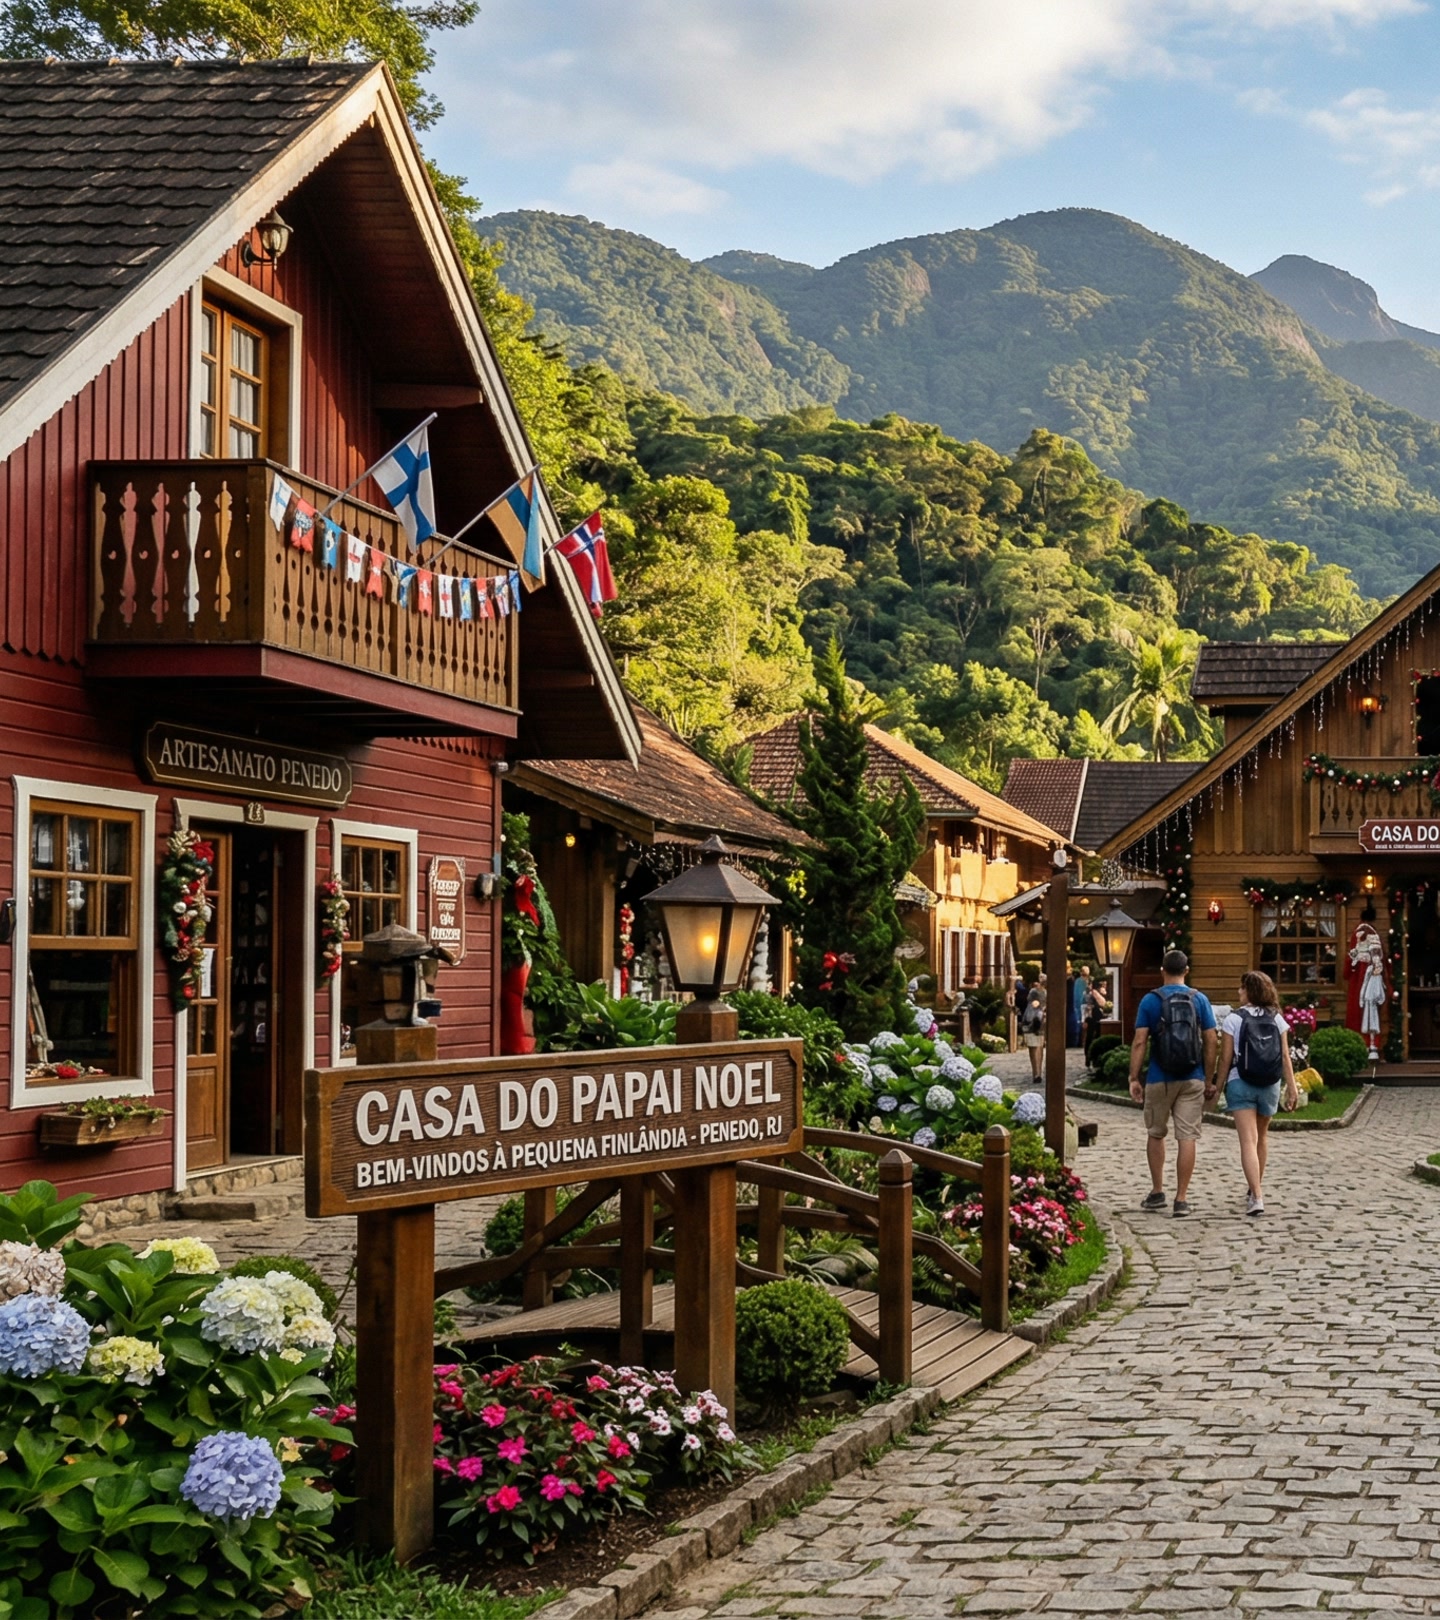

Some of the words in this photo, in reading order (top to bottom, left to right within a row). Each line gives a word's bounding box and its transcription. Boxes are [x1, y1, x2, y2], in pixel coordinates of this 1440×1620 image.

[159, 737, 276, 782] ARTESANATO
[281, 758, 342, 792] PENEDO
[1371, 825, 1413, 842] CASA
[1417, 825, 1440, 842] DO
[356, 1084, 486, 1146] CASA
[499, 1077, 559, 1131] DO
[572, 1068, 682, 1123] PAPAI
[695, 1061, 781, 1111] NOEL
[357, 1149, 490, 1188] BEM-VINDOS
[492, 1141, 508, 1171] À
[511, 1136, 598, 1169] PEQUENA
[601, 1125, 688, 1157] FINLÂNDIA
[700, 1118, 764, 1145] PENEDO,
[766, 1115, 783, 1137] RJ
